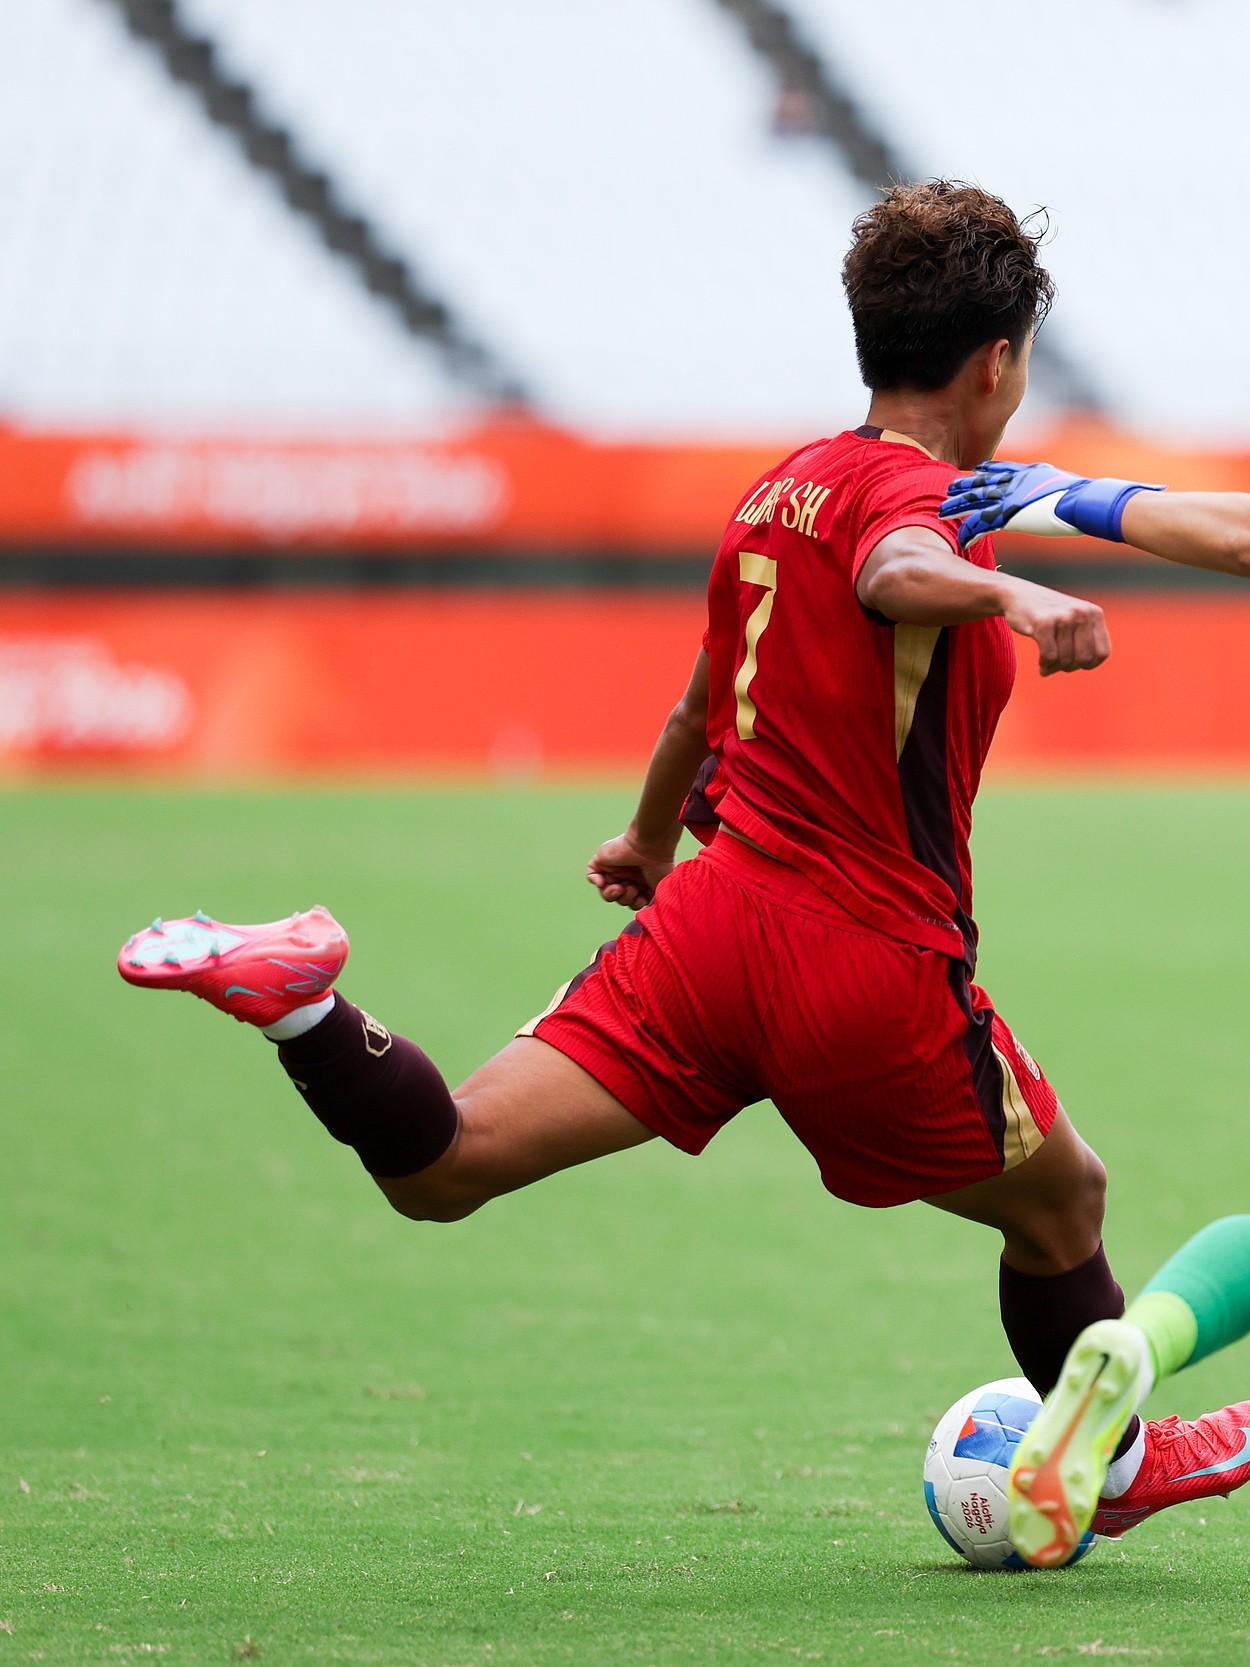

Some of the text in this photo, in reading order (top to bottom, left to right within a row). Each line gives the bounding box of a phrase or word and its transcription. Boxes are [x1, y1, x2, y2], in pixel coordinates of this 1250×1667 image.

[781, 480, 832, 539] SH.
[734, 551, 777, 741] 7
[961, 1501, 974, 1528] 2026
[970, 1492, 987, 1535] Nagoya
[979, 1496, 995, 1529] Aichi-
